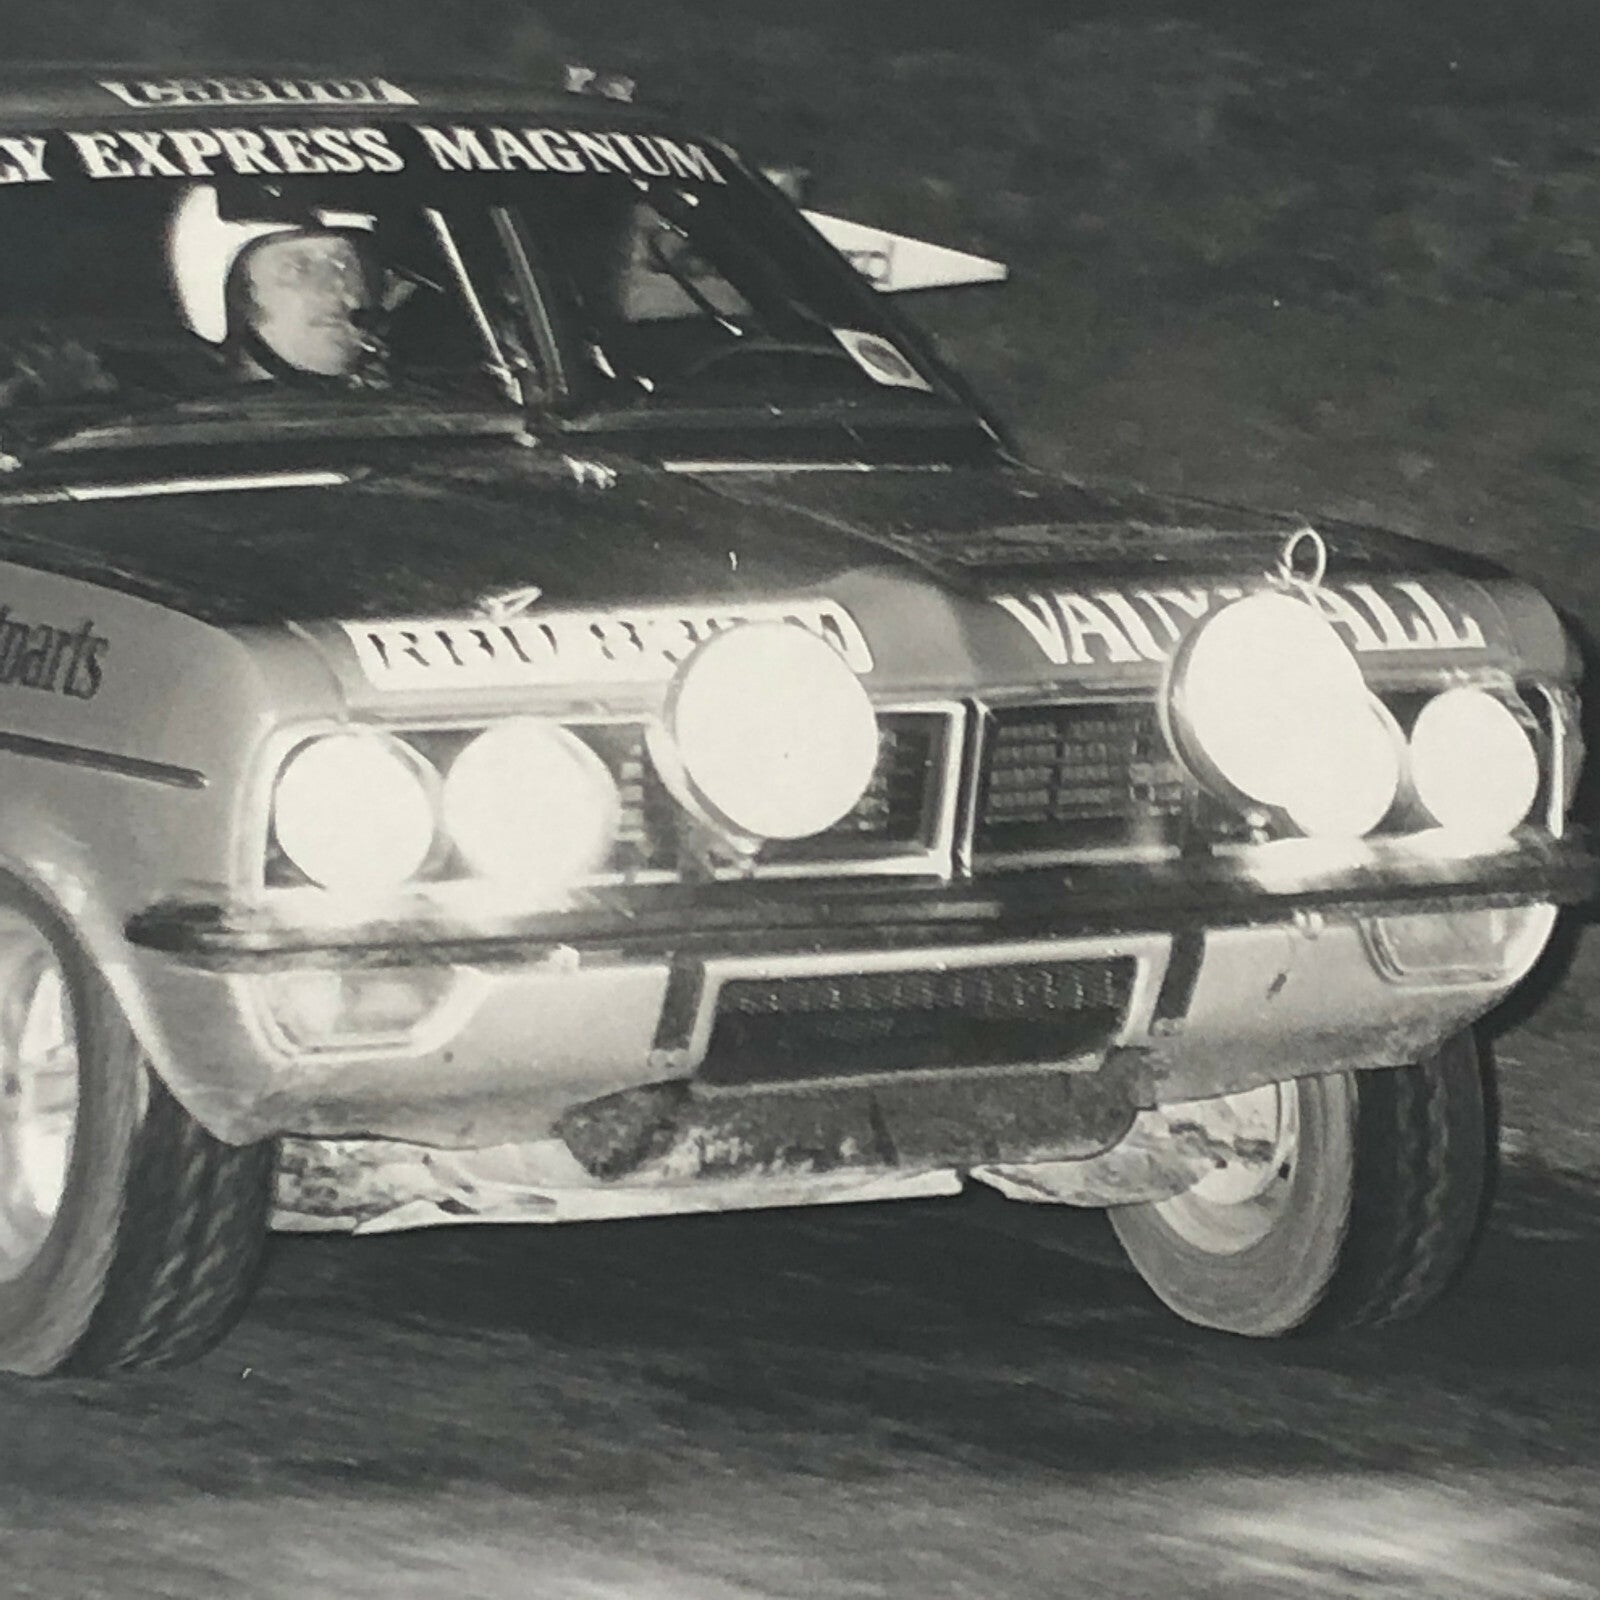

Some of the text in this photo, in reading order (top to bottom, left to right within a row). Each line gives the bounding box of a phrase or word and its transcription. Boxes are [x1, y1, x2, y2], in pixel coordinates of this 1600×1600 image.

[63, 127, 405, 178] EXPRESS
[413, 125, 727, 184] MAGNUM
[0, 604, 109, 700] parts
[997, 583, 1486, 664] VAUALL
